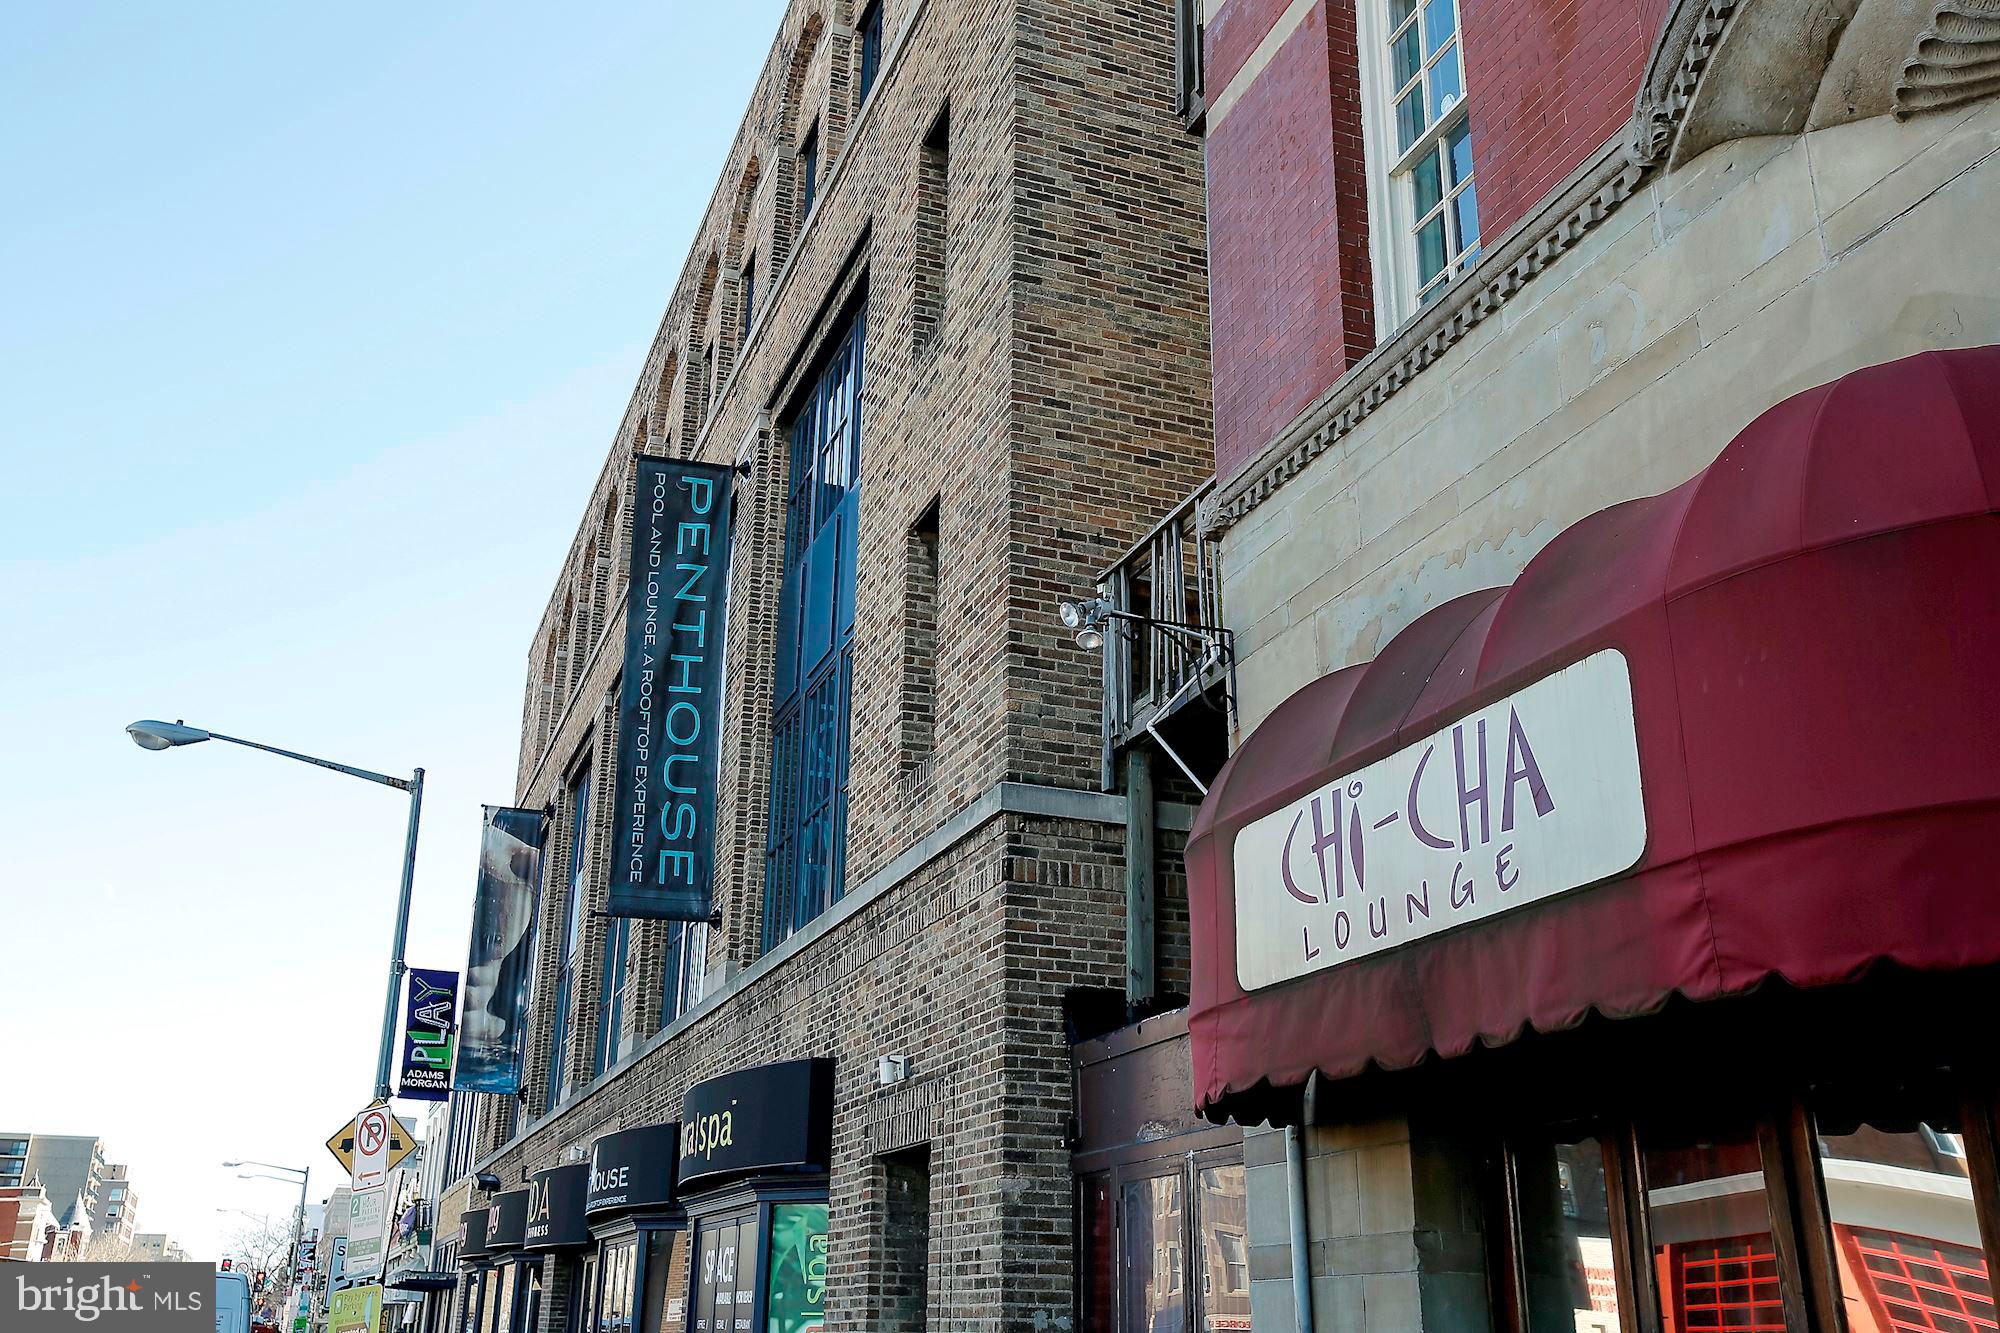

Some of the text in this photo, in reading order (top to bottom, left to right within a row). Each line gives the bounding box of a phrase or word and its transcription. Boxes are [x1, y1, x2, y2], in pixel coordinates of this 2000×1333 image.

[630, 472, 666, 883] POOL AND LOUNGE. A ROOFTOP EXPERIENCE
[658, 476, 713, 885] PENTHOUSE
[1302, 843, 1520, 962] LOUNGE
[410, 976, 453, 1062] PLAY
[401, 1078, 448, 1090] MORGAN
[407, 1069, 445, 1080] ADAMS
[352, 1198, 359, 1214] 2
[704, 1247, 735, 1285] SPACE
